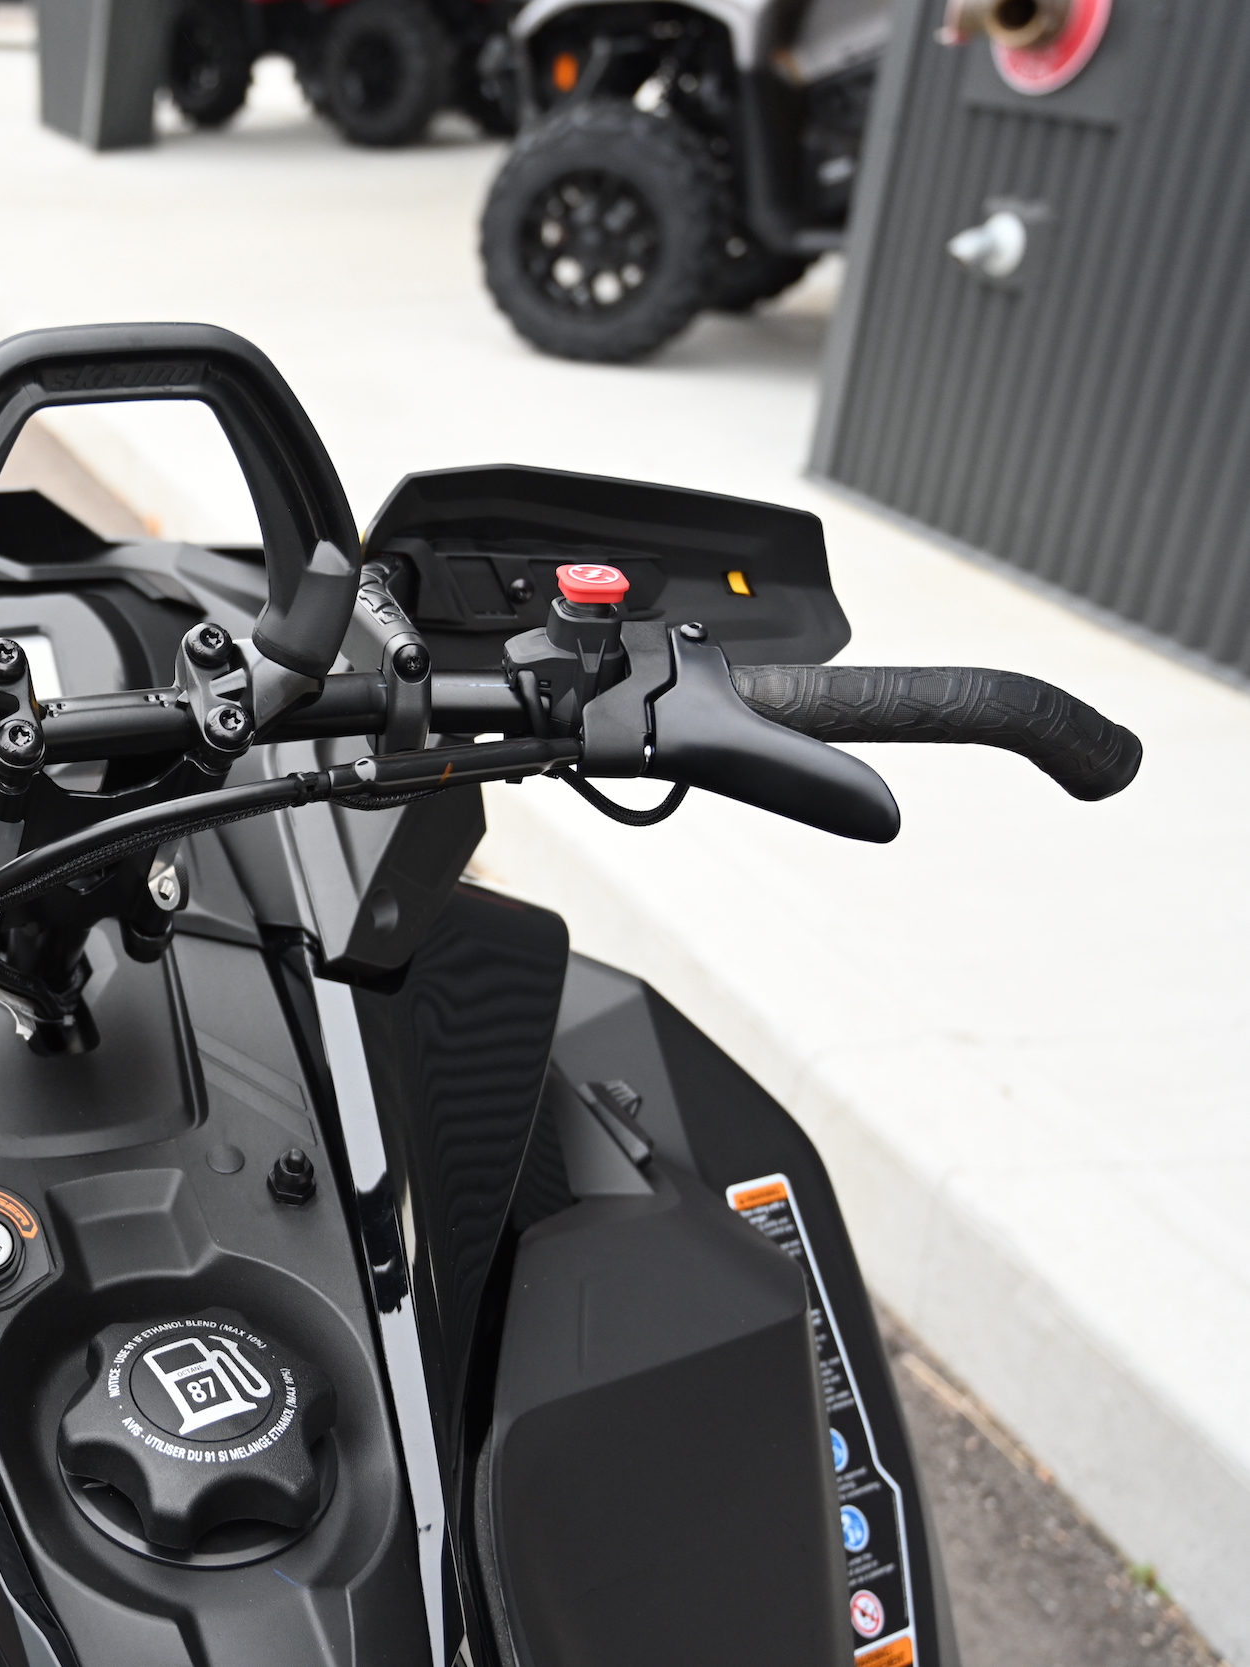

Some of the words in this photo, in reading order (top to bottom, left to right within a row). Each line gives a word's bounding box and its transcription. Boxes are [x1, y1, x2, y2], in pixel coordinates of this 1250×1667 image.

[108, 1368, 121, 1398] NOTICE
[116, 1347, 131, 1365] USE
[125, 1340, 137, 1351] 91
[132, 1333, 144, 1345] IF
[142, 1320, 185, 1339] ETHANOL
[185, 1319, 218, 1329] BLEND
[219, 1323, 246, 1337] (MAX
[246, 1333, 268, 1349] 10%)
[176, 1363, 205, 1378] OCTANE
[186, 1376, 217, 1403] 87
[121, 1416, 143, 1438] AVIS
[144, 1434, 187, 1459] UTILISER
[187, 1450, 203, 1462] DU
[204, 1451, 217, 1463] 91
[218, 1450, 230, 1463] SI
[230, 1434, 273, 1462] MELANGE
[267, 1406, 296, 1442] ETHANOL
[285, 1386, 298, 1409] (MAX
